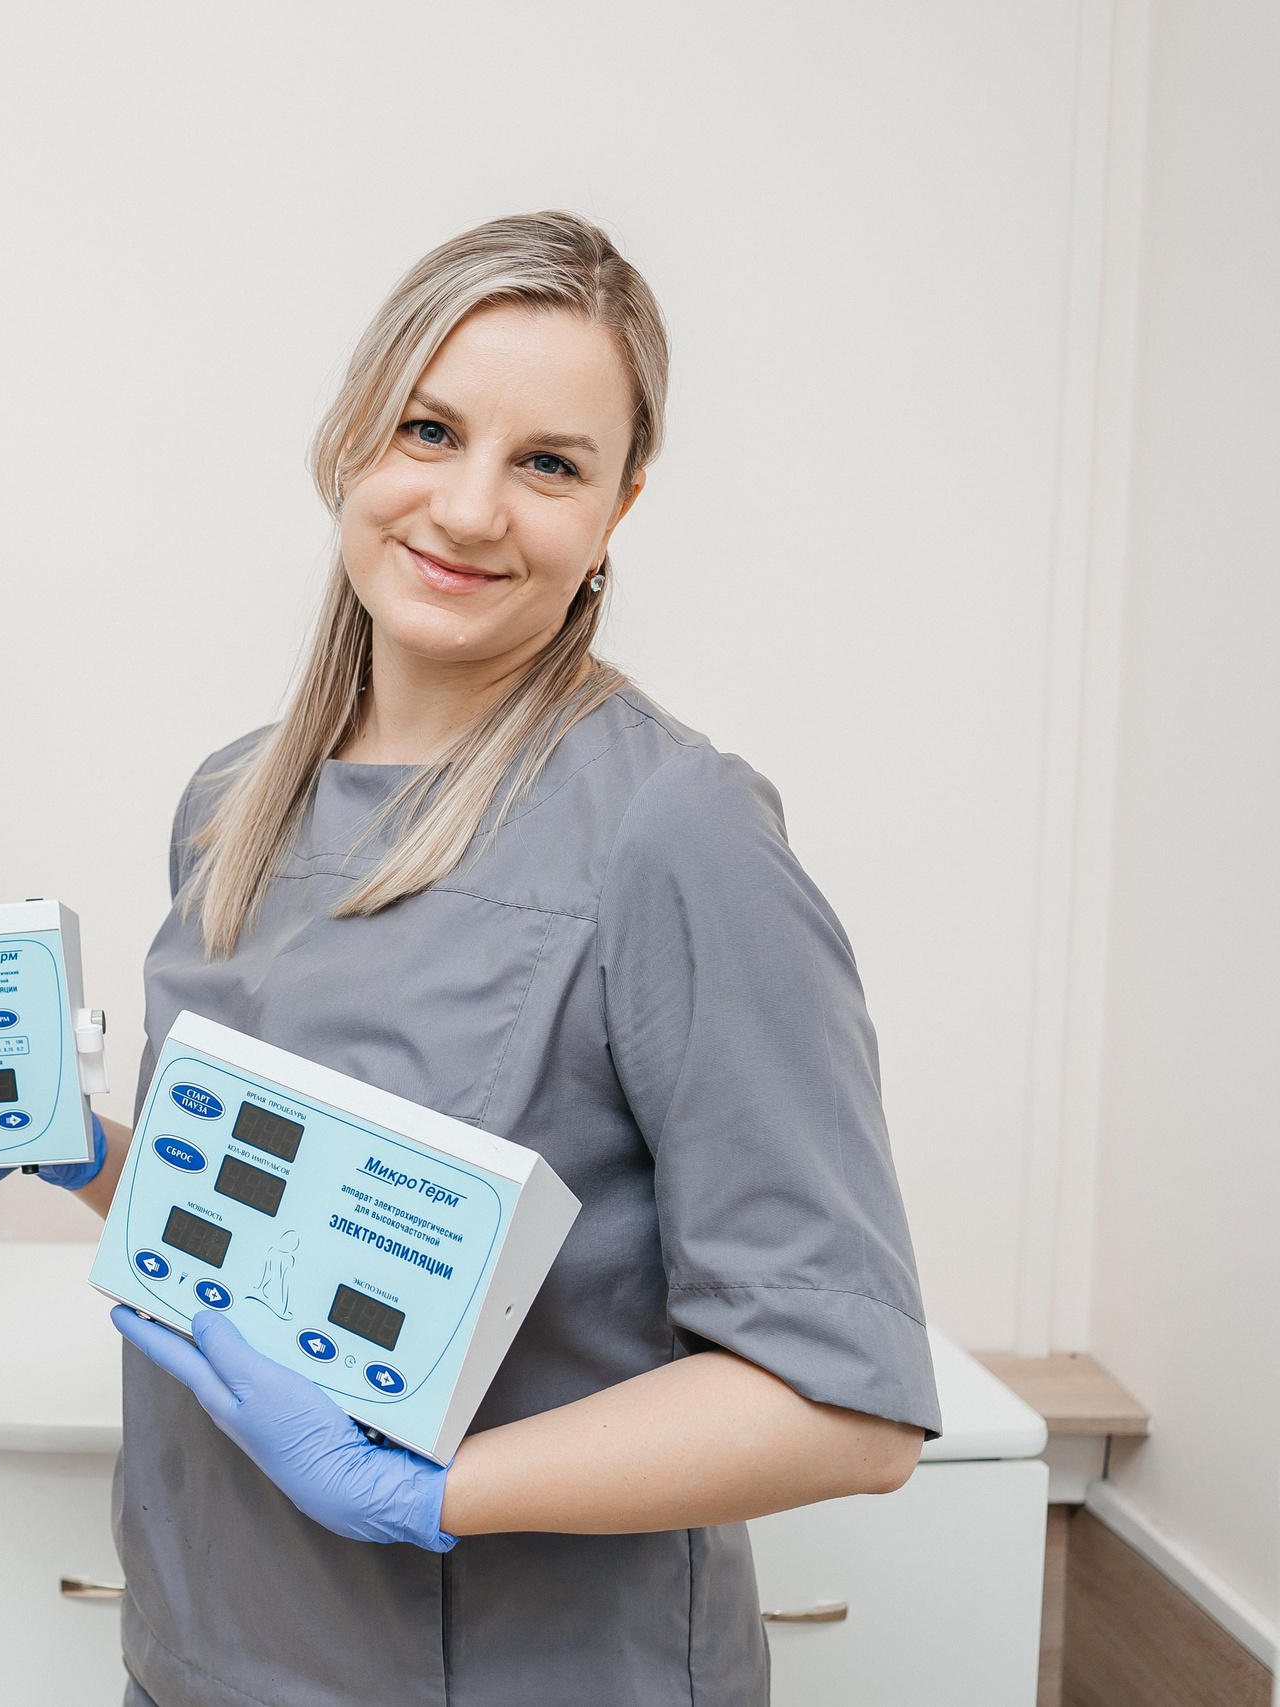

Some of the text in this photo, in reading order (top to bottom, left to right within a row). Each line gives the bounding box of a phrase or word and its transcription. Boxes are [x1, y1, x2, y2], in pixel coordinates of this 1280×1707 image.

[181, 1098, 208, 1115] ПАУЗА
[186, 1087, 211, 1104] СТАРТ
[246, 1090, 307, 1121] ВРЕМЯ ПРОЦЕДУРЫ
[165, 1145, 194, 1164] СБРОС
[227, 1143, 291, 1176] КОЛ-ВО ИМПУЛЬСОВ
[363, 1156, 460, 1208] МикроТерм
[186, 1200, 224, 1222] МОЩНОСТЬ
[340, 1184, 464, 1243] аппарат электрохирургический
[354, 1203, 441, 1247] для высокочастотной
[328, 1213, 454, 1280] ЭЛЕКТРОЭПИЛЯЦИИ
[352, 1276, 400, 1304] ЭКСПОЗИЦИЯ
